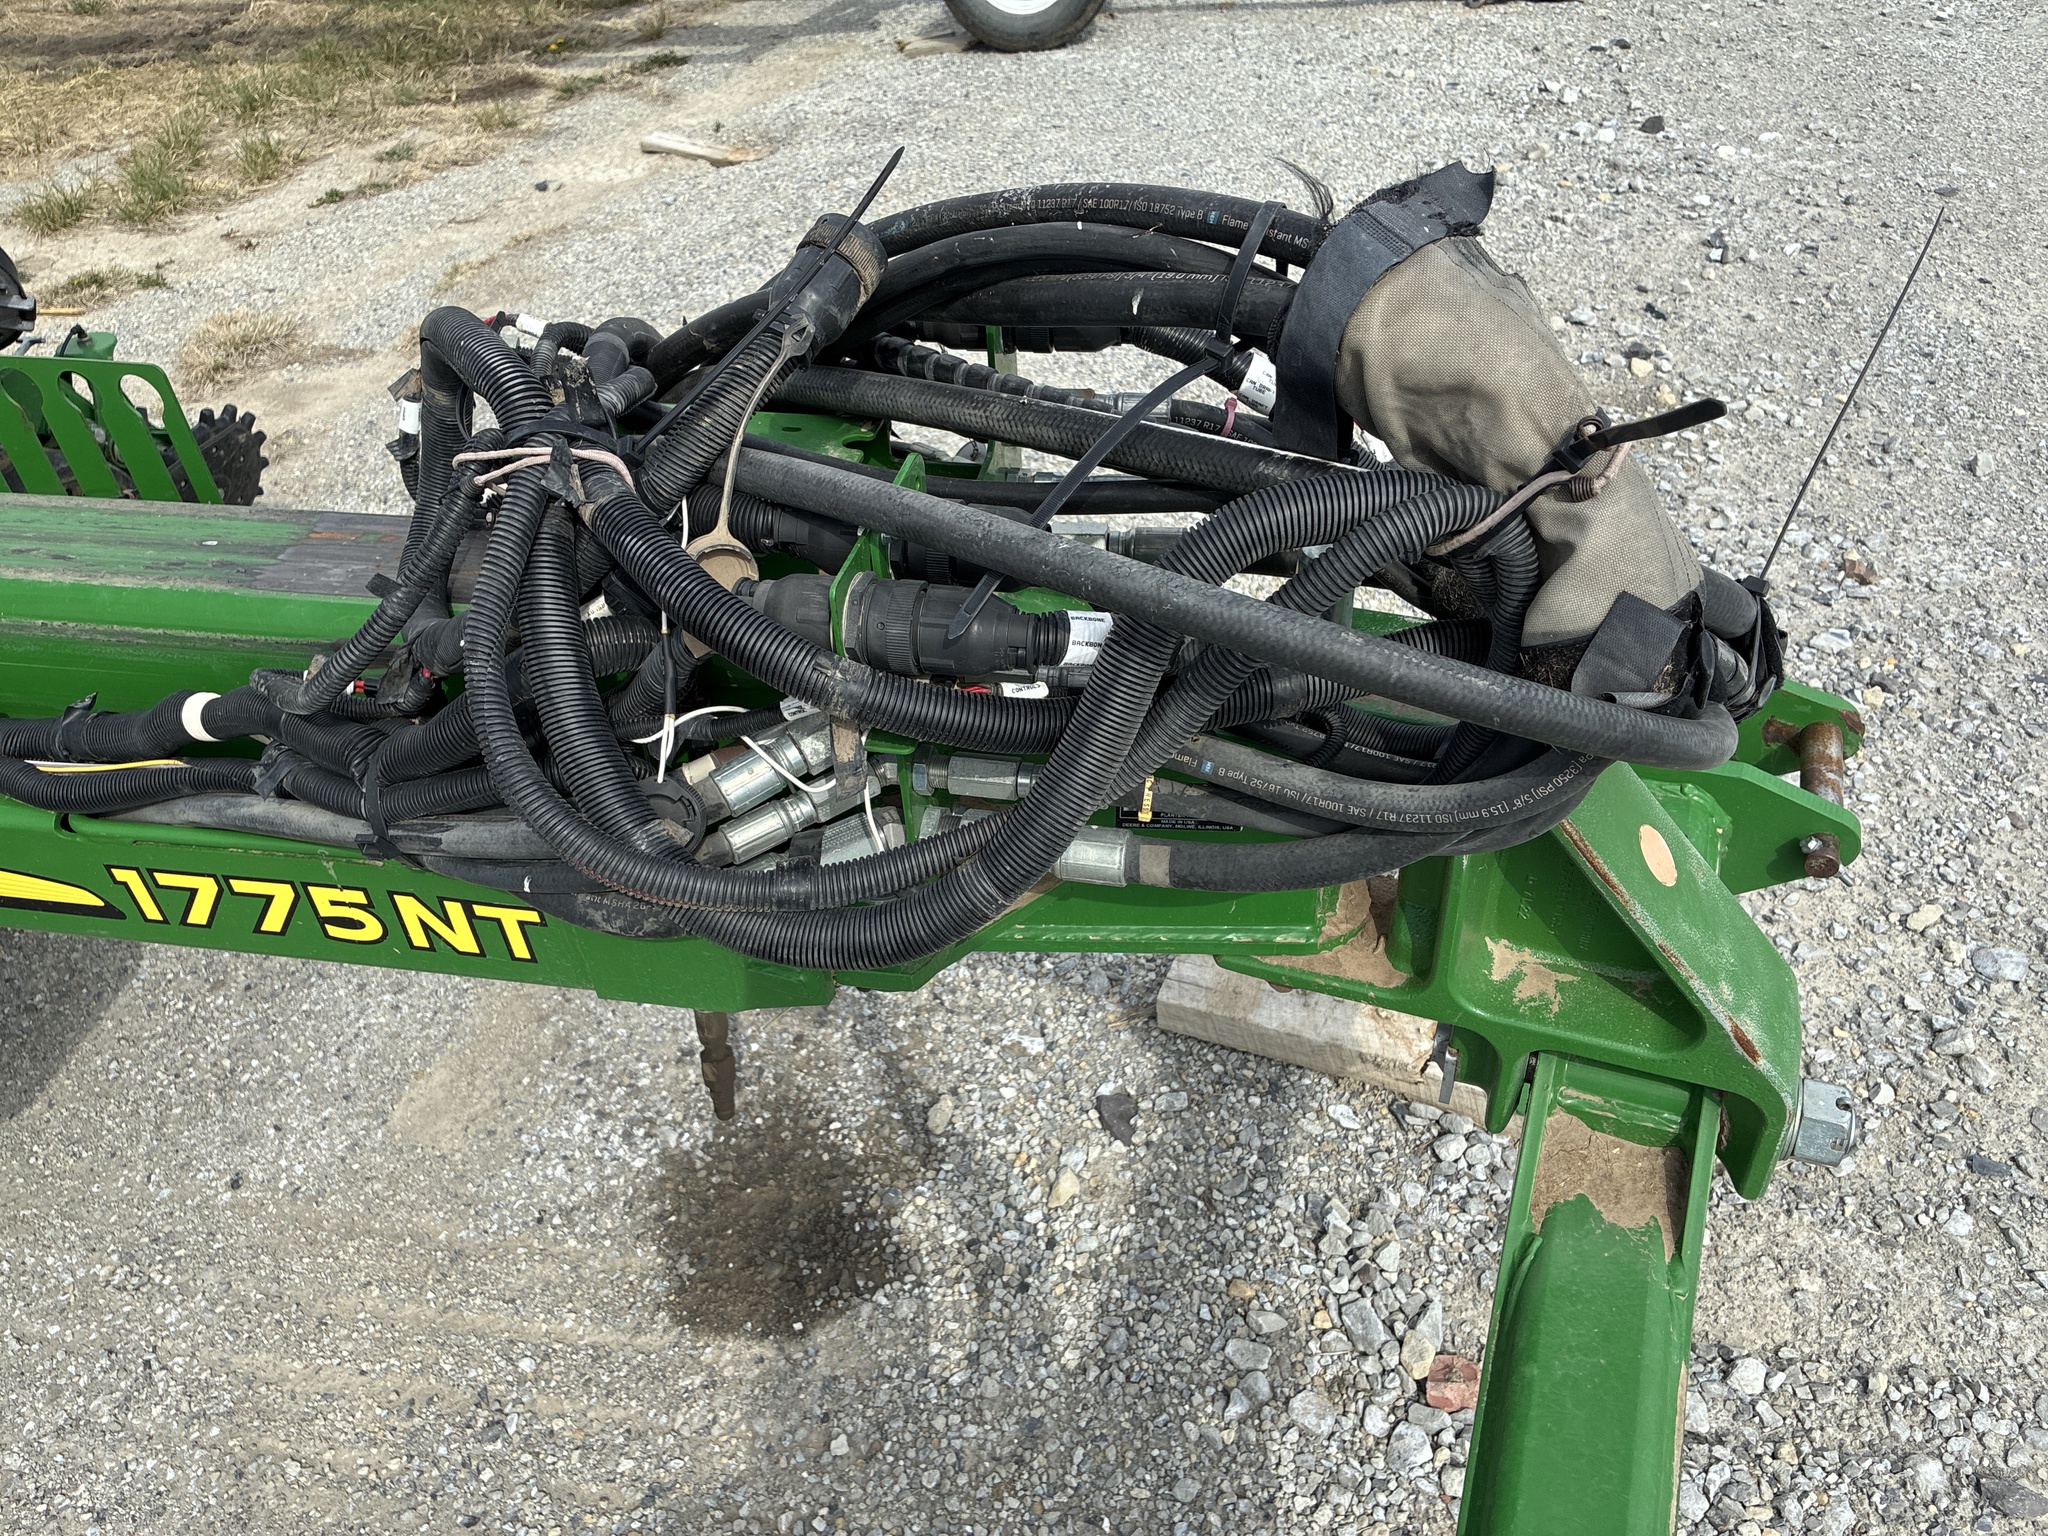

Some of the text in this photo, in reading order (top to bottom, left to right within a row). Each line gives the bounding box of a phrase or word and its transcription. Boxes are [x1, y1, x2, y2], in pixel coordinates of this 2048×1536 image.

[1038, 199, 1060, 209] 11237
[1082, 199, 1097, 208] SAE
[1149, 202, 1175, 215] 18752
[1176, 205, 1196, 219] Type
[1197, 210, 1204, 220] B
[1221, 214, 1249, 231] Flame
[1174, 416, 1202, 427] 11237
[1203, 421, 1221, 432] R17
[1071, 640, 1103, 648] BACKBON
[1218, 767, 1226, 777] B
[1226, 769, 1248, 785] Type
[1249, 777, 1281, 795] 18752
[1347, 805, 1367, 817] SAE
[1376, 811, 1397, 822] R17
[1399, 813, 1433, 824] 11237
[1434, 814, 1453, 824] ISO
[602, 899, 632, 909] MSHA
